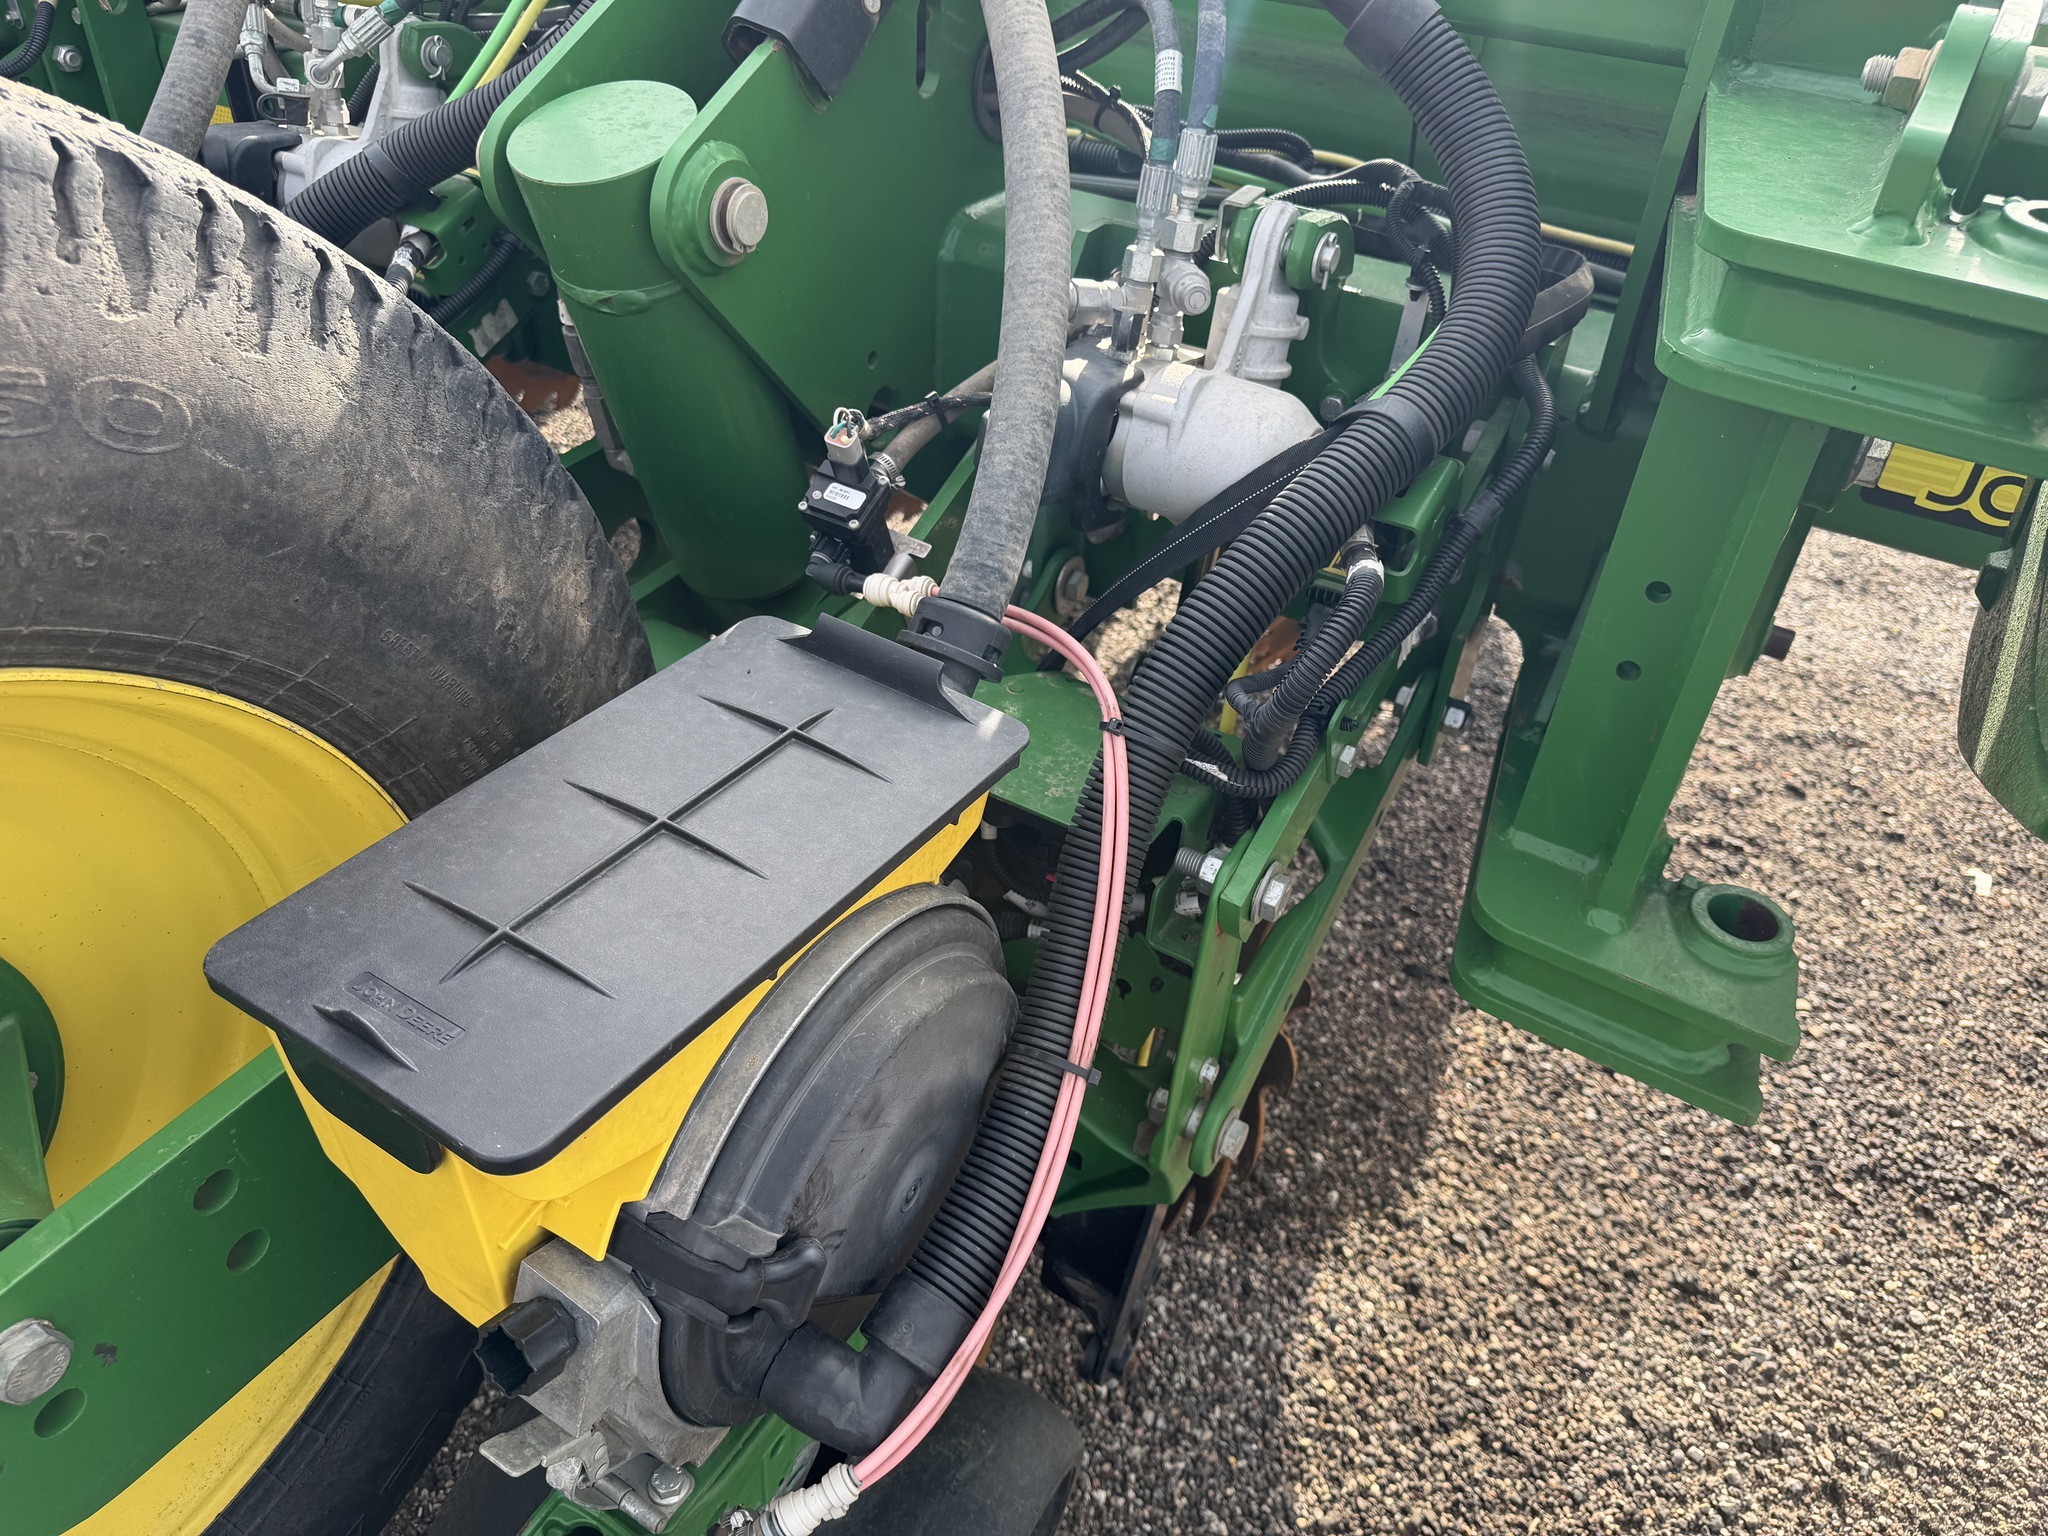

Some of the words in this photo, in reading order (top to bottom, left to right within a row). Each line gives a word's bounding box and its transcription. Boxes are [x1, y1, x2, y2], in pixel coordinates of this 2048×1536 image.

[381, 628, 427, 662] SAFETY
[429, 664, 474, 707] WARNING
[351, 981, 401, 1013] JOHN
[395, 1004, 456, 1046] DEERE
